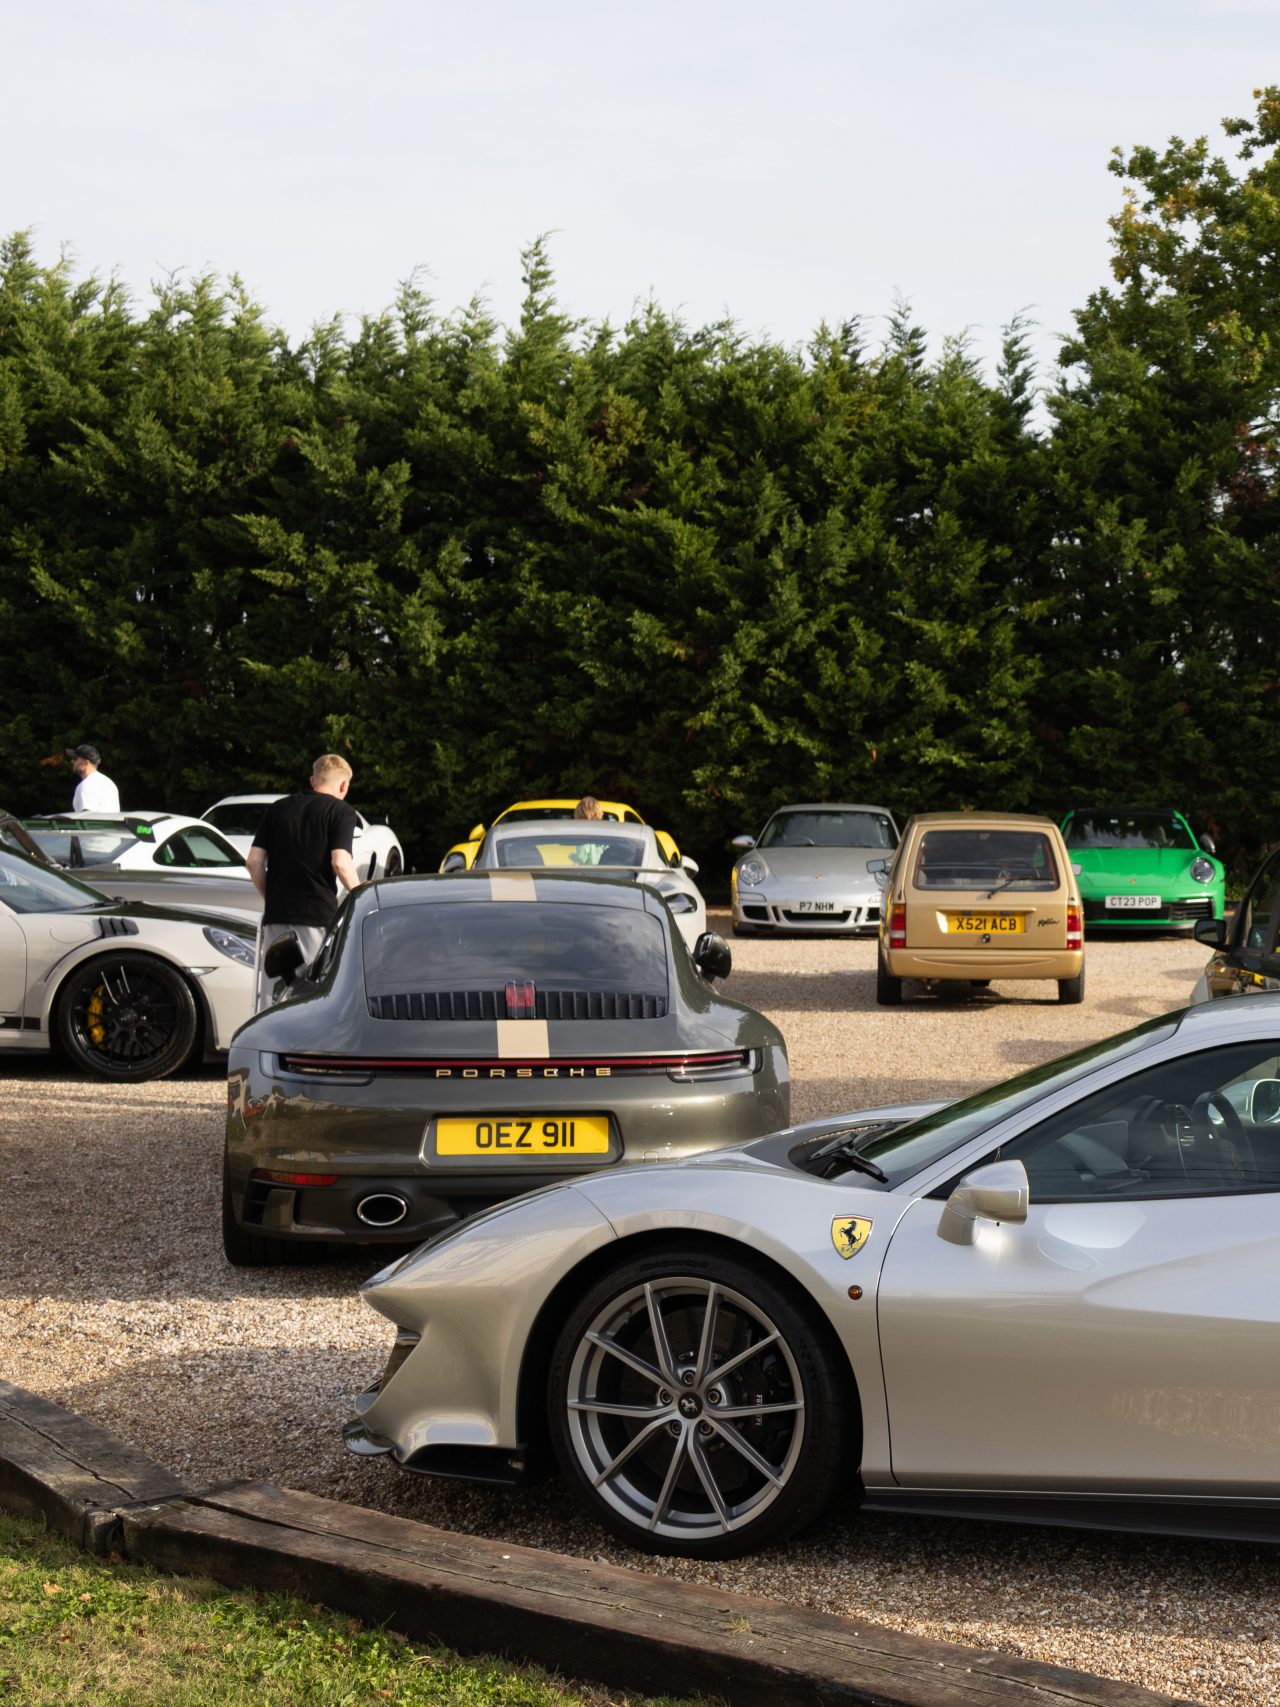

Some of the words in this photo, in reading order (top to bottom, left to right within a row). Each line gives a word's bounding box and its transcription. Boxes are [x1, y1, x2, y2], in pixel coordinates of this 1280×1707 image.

[799, 901, 812, 911] P7
[1110, 897, 1136, 906] CT23
[1138, 897, 1157, 906] POP
[956, 918, 987, 930] X521
[991, 918, 1017, 930] ACB
[436, 1067, 611, 1078] PORSCHE
[476, 1122, 532, 1148] OEZ
[542, 1122, 575, 1147] 911
